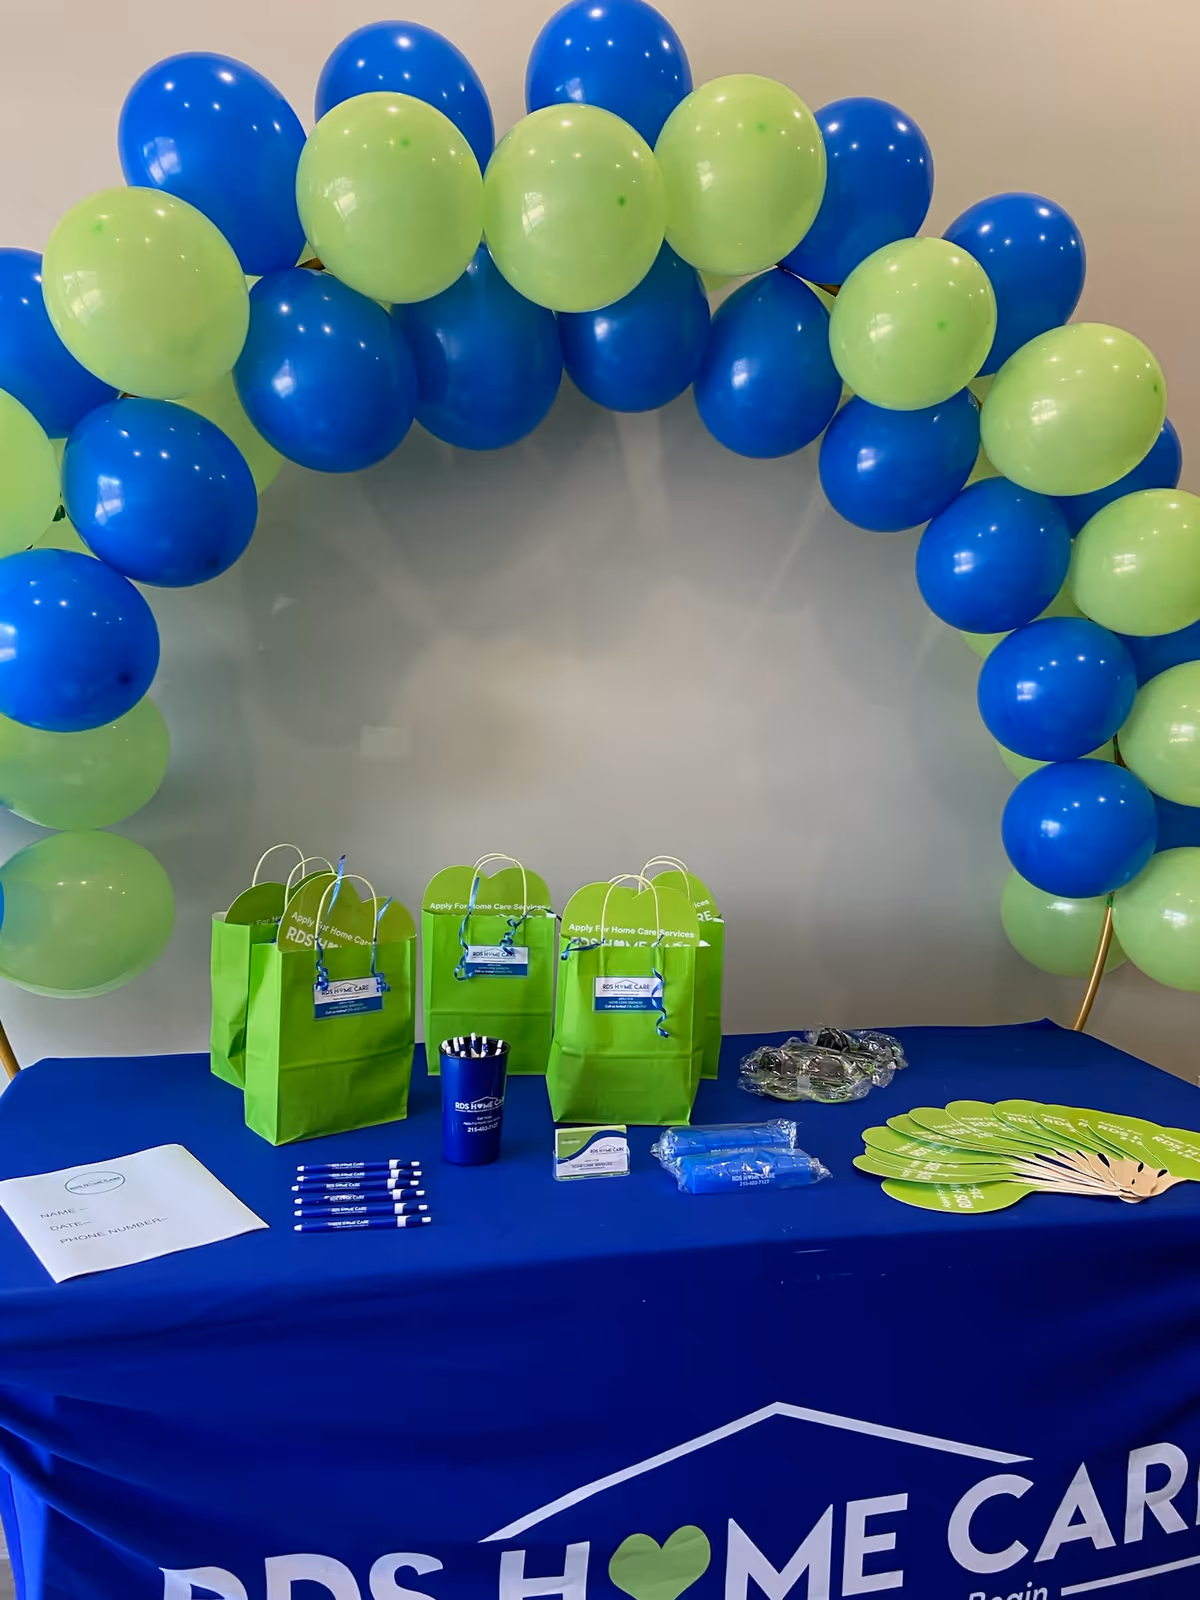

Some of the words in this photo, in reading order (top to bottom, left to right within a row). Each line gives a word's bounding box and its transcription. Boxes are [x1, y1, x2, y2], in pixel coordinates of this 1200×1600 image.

[429, 902, 452, 910] Apply
[291, 911, 315, 928] Apply
[330, 926, 353, 941] Home
[568, 923, 593, 934] Apply
[611, 926, 636, 935] Home
[638, 927, 657, 936] Care
[286, 926, 314, 947] RDS
[455, 1101, 470, 1110] RDS
[40, 1207, 76, 1219] NAME
[60, 1231, 107, 1244] PHONE
[947, 1442, 1200, 1574] CAR
